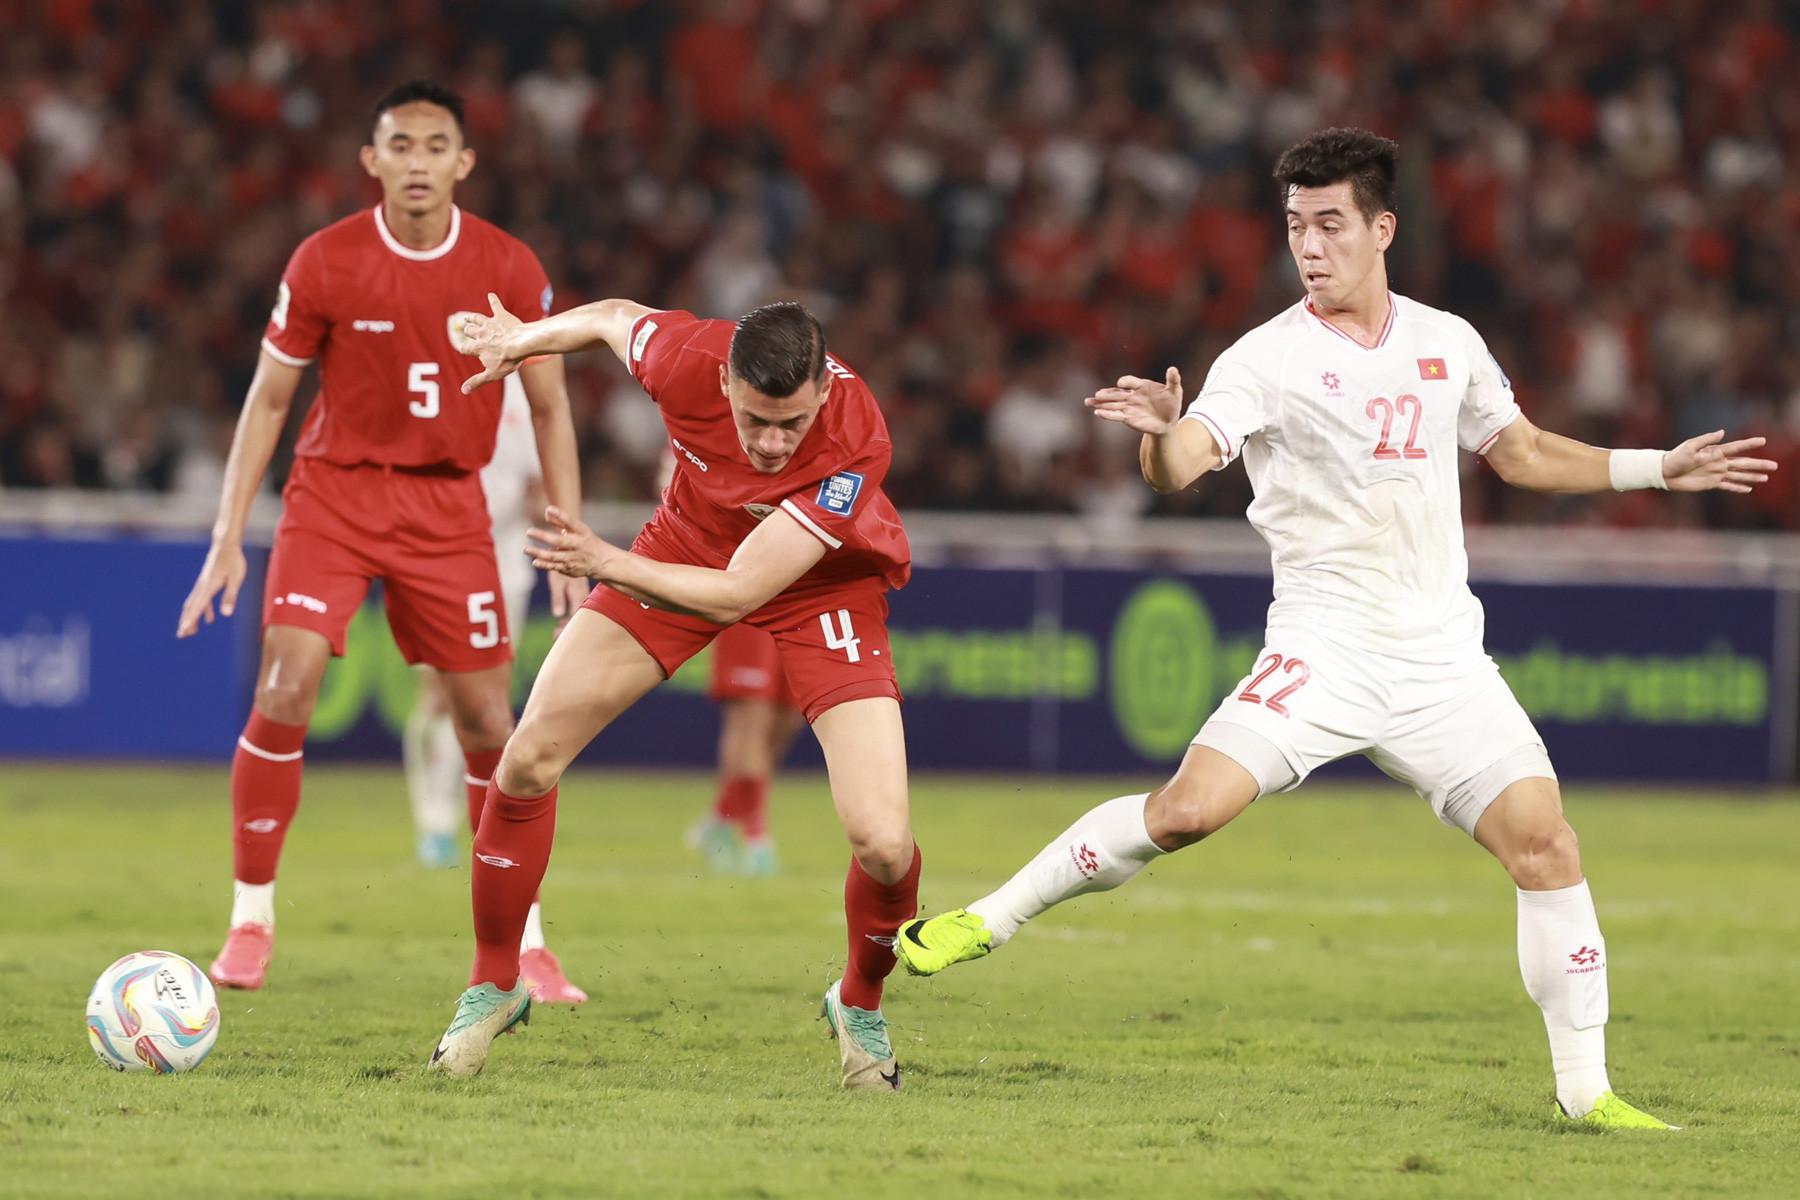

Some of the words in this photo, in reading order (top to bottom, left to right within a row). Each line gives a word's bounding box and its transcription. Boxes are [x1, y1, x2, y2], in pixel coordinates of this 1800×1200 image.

[408, 362, 440, 418] 5
[825, 354, 856, 379] ID
[1366, 394, 1427, 460] 22
[467, 590, 499, 649] 5
[818, 609, 861, 662] 4
[1237, 653, 1311, 719] 22
